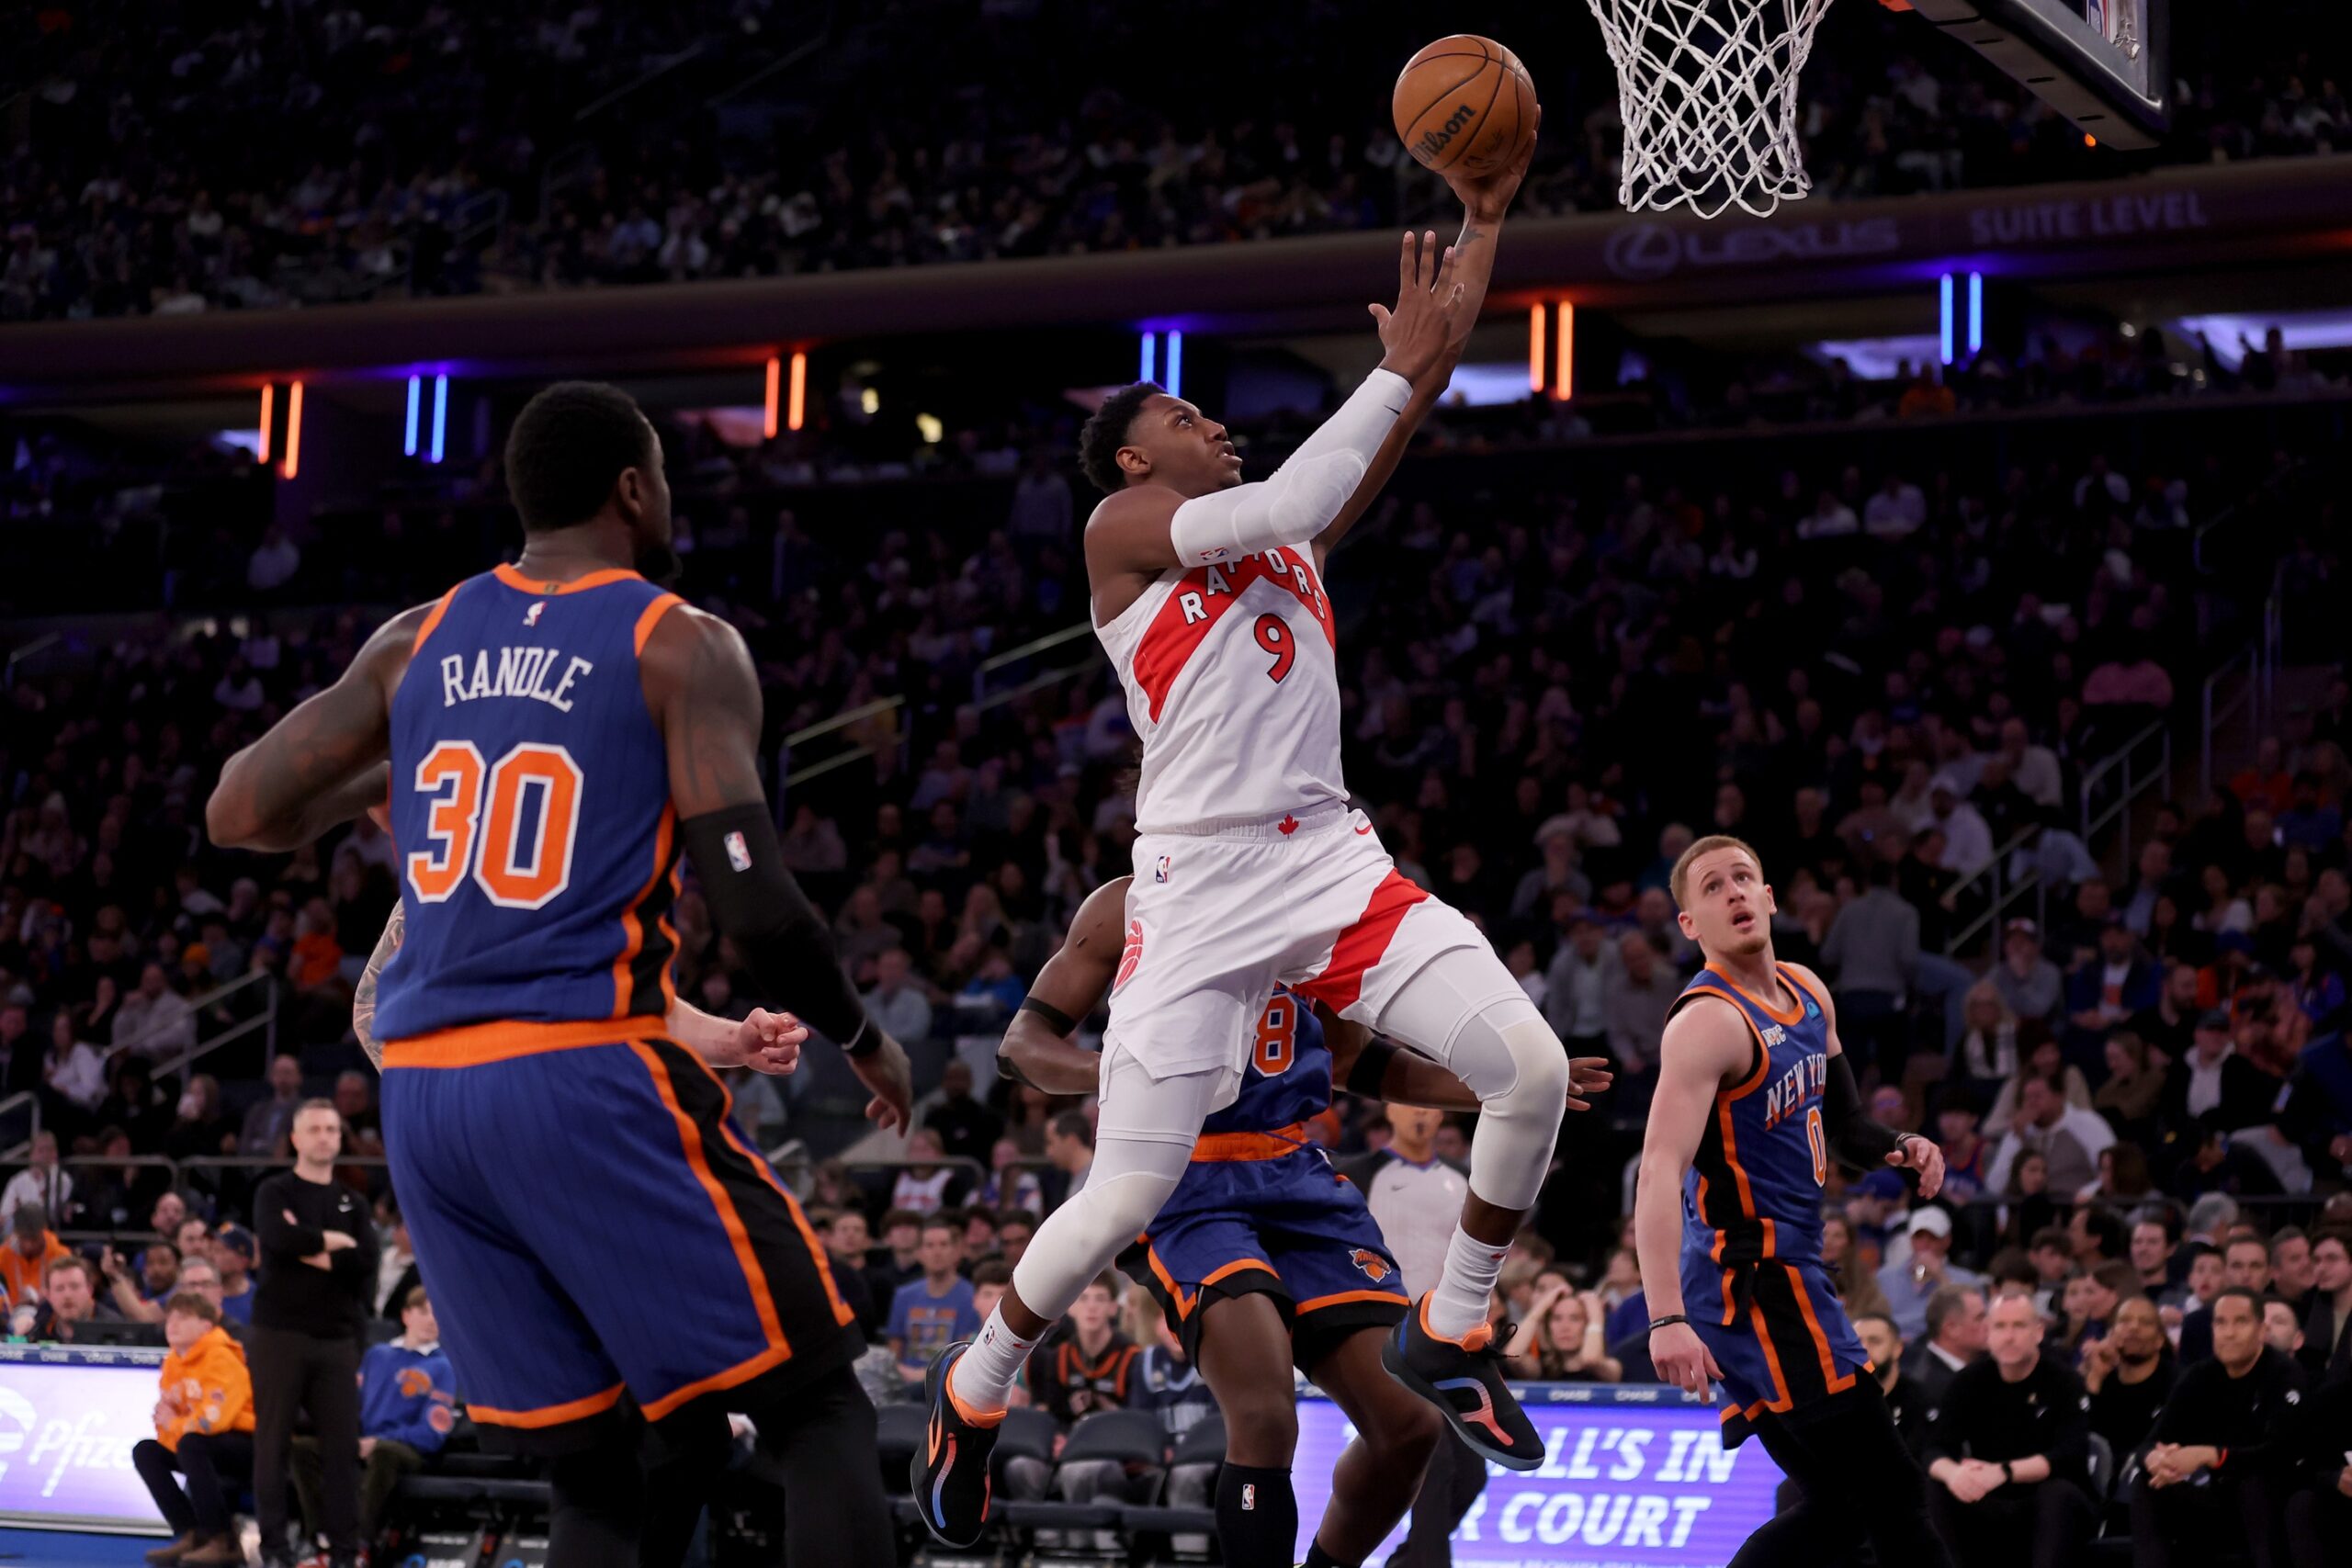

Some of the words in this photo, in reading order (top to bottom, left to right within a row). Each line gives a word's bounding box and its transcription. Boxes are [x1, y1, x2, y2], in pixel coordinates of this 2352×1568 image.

[1685, 217, 1898, 265] LEXUS
[1970, 201, 2083, 245] SUITE
[2091, 192, 2207, 235] LEVEL
[440, 646, 594, 714] RANDLE
[1253, 613, 1296, 684] 9
[407, 739, 584, 910] 30
[1251, 993, 1298, 1077] 8
[1765, 1059, 1806, 1132] NEW
[1806, 1105, 1827, 1189] 0
[1655, 1430, 1741, 1483] IN
[1498, 1492, 1713, 1548] COURT
